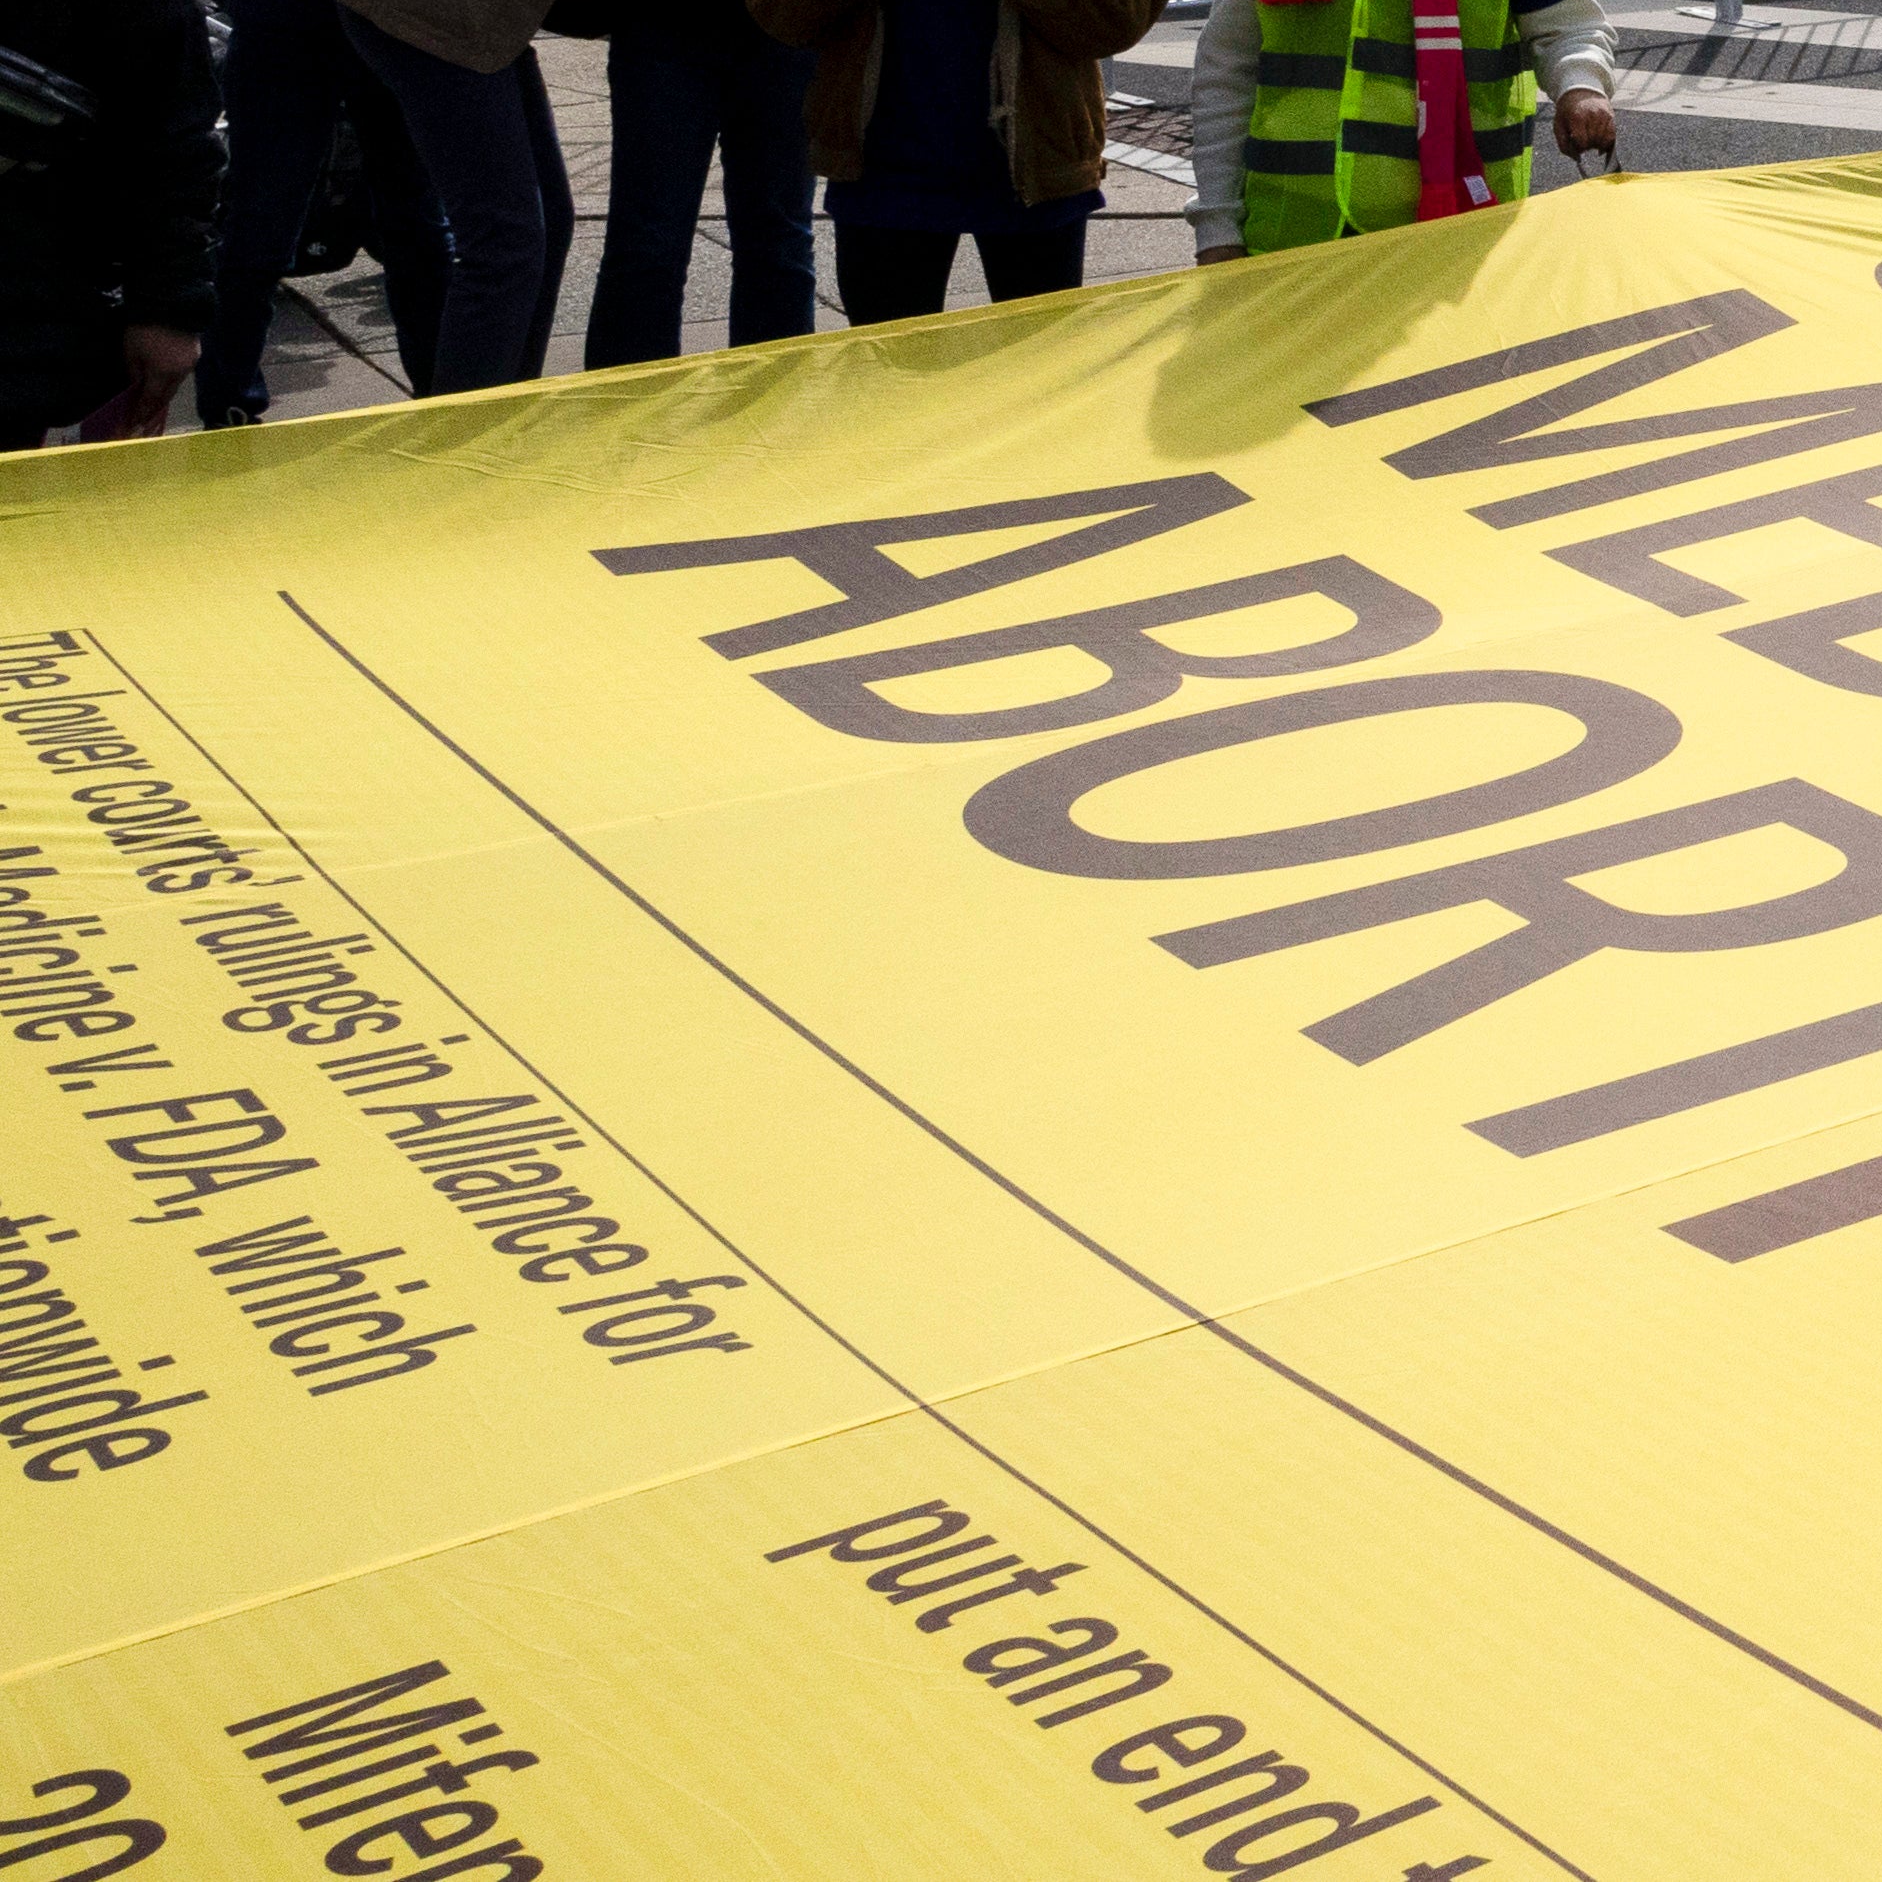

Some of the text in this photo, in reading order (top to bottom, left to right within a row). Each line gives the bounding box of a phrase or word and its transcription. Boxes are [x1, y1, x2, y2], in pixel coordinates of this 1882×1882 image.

[0, 630, 753, 1366] The lower courts' rulings in Alliance for
[47, 1042, 174, 1092] v.
[83, 1087, 321, 1224] FDA,
[194, 1214, 477, 1397] which
[763, 1497, 1443, 1882] put an end
